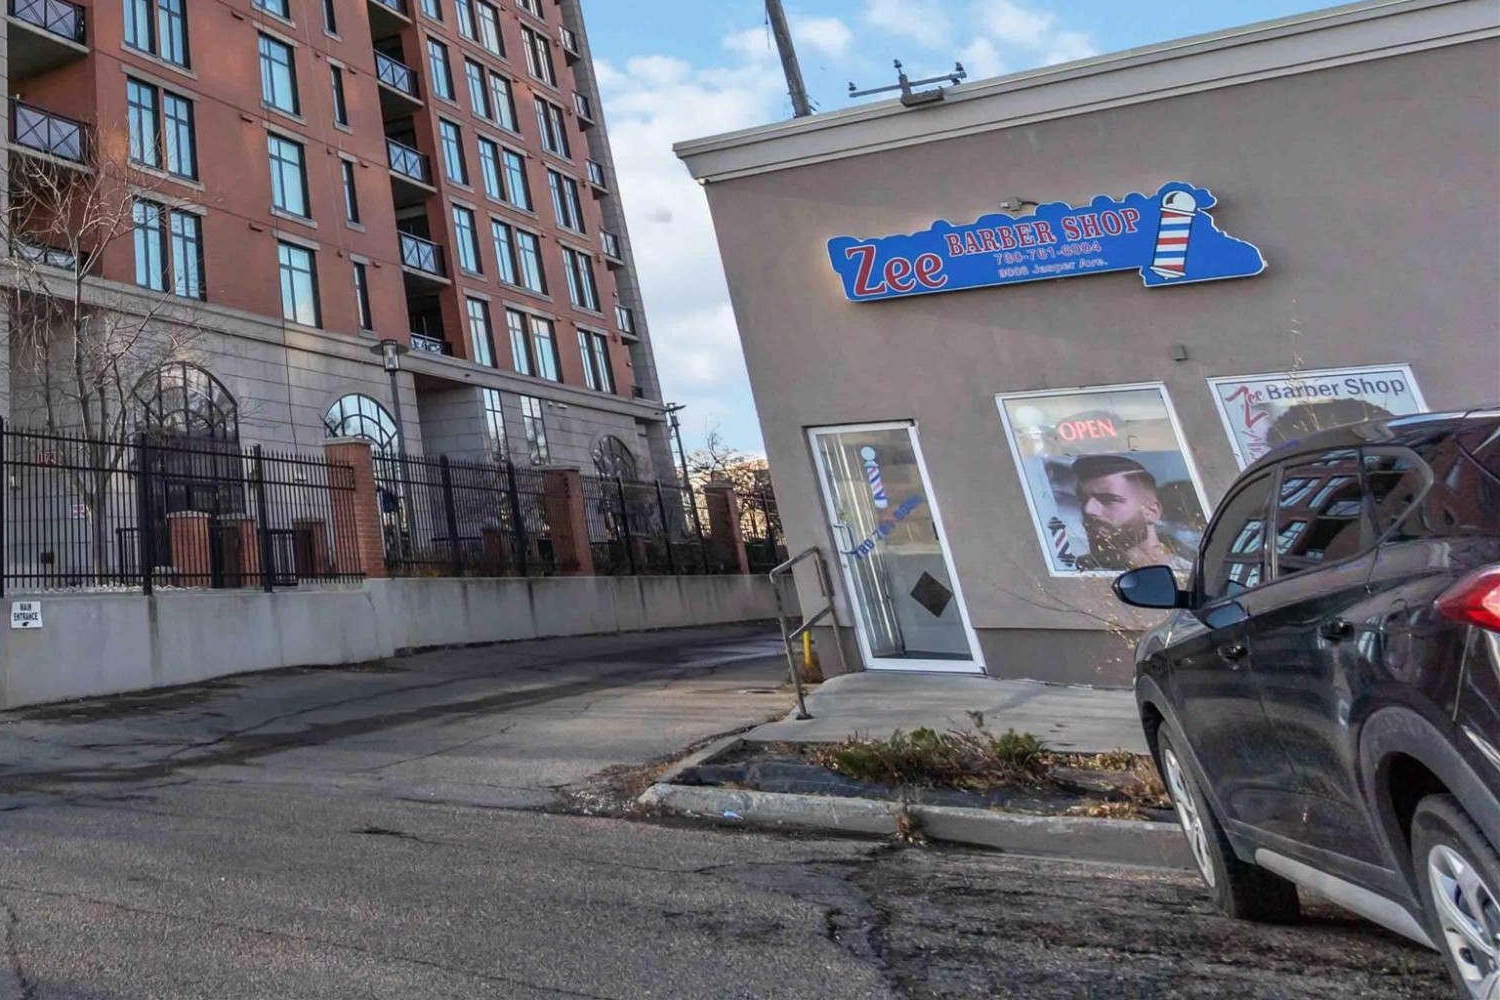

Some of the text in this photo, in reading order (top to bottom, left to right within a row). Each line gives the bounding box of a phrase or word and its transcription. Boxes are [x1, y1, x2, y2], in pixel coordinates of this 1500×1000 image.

[846, 207, 1141, 296] Zee BARBER SHOP
[1266, 382, 1340, 401] Barber
[1344, 377, 1406, 397] Shop
[1058, 418, 1117, 442] OPEN
[13, 612, 38, 621] ENTRANCE
[19, 603, 32, 612] MAIN
